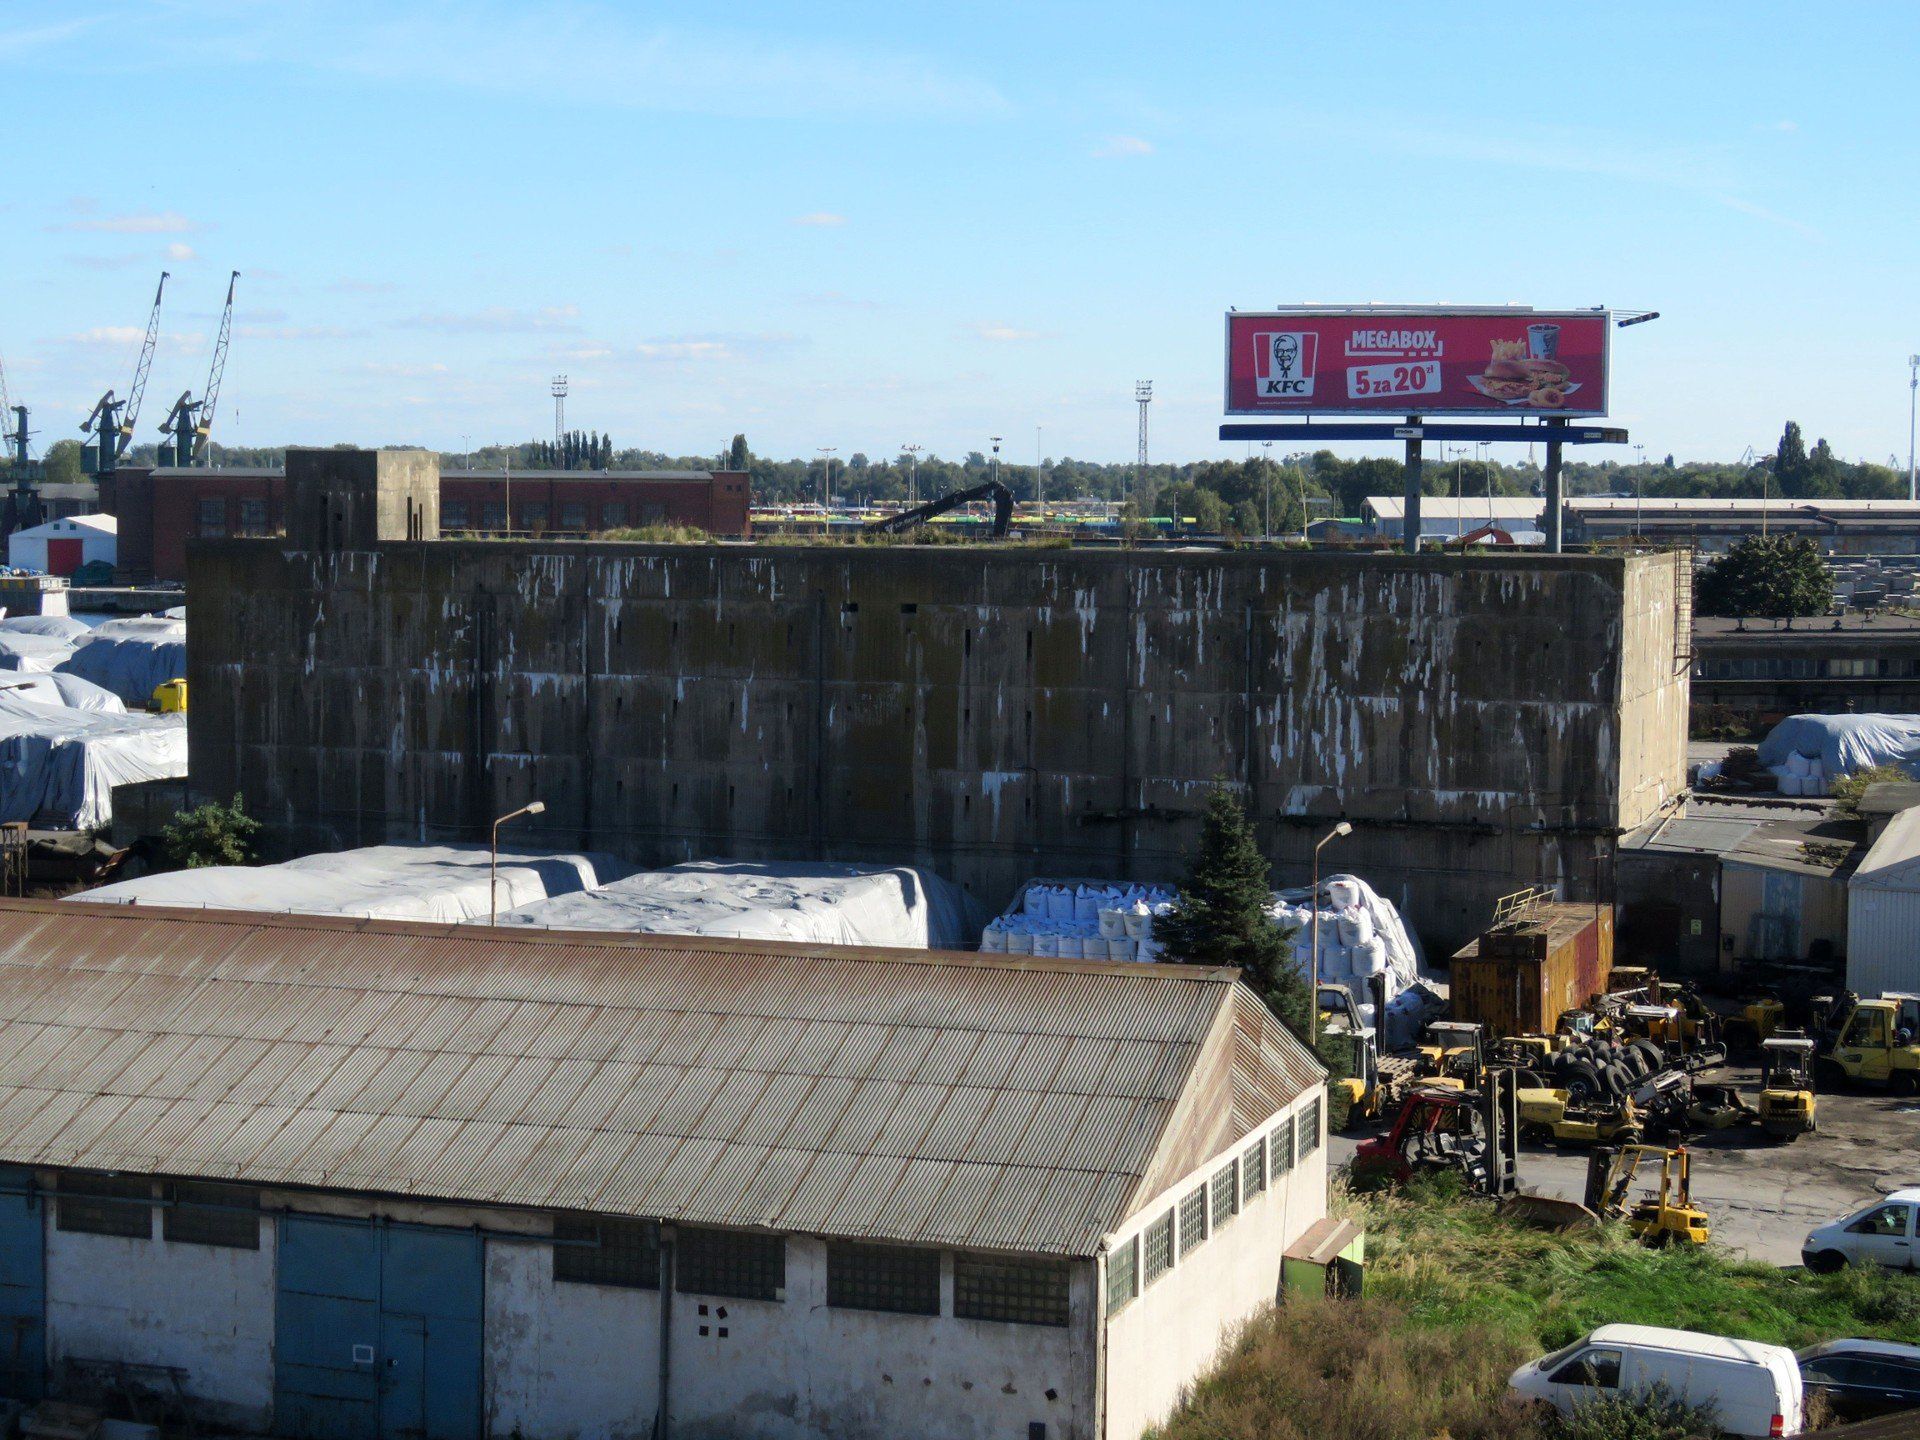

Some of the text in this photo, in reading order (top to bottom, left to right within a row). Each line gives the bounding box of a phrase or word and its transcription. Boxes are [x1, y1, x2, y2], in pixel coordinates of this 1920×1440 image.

[1352, 330, 1436, 349] MEGABOX
[1266, 380, 1306, 394] KFC
[1356, 370, 1371, 395] 5
[1373, 380, 1392, 394] za
[1393, 366, 1427, 392] 20
